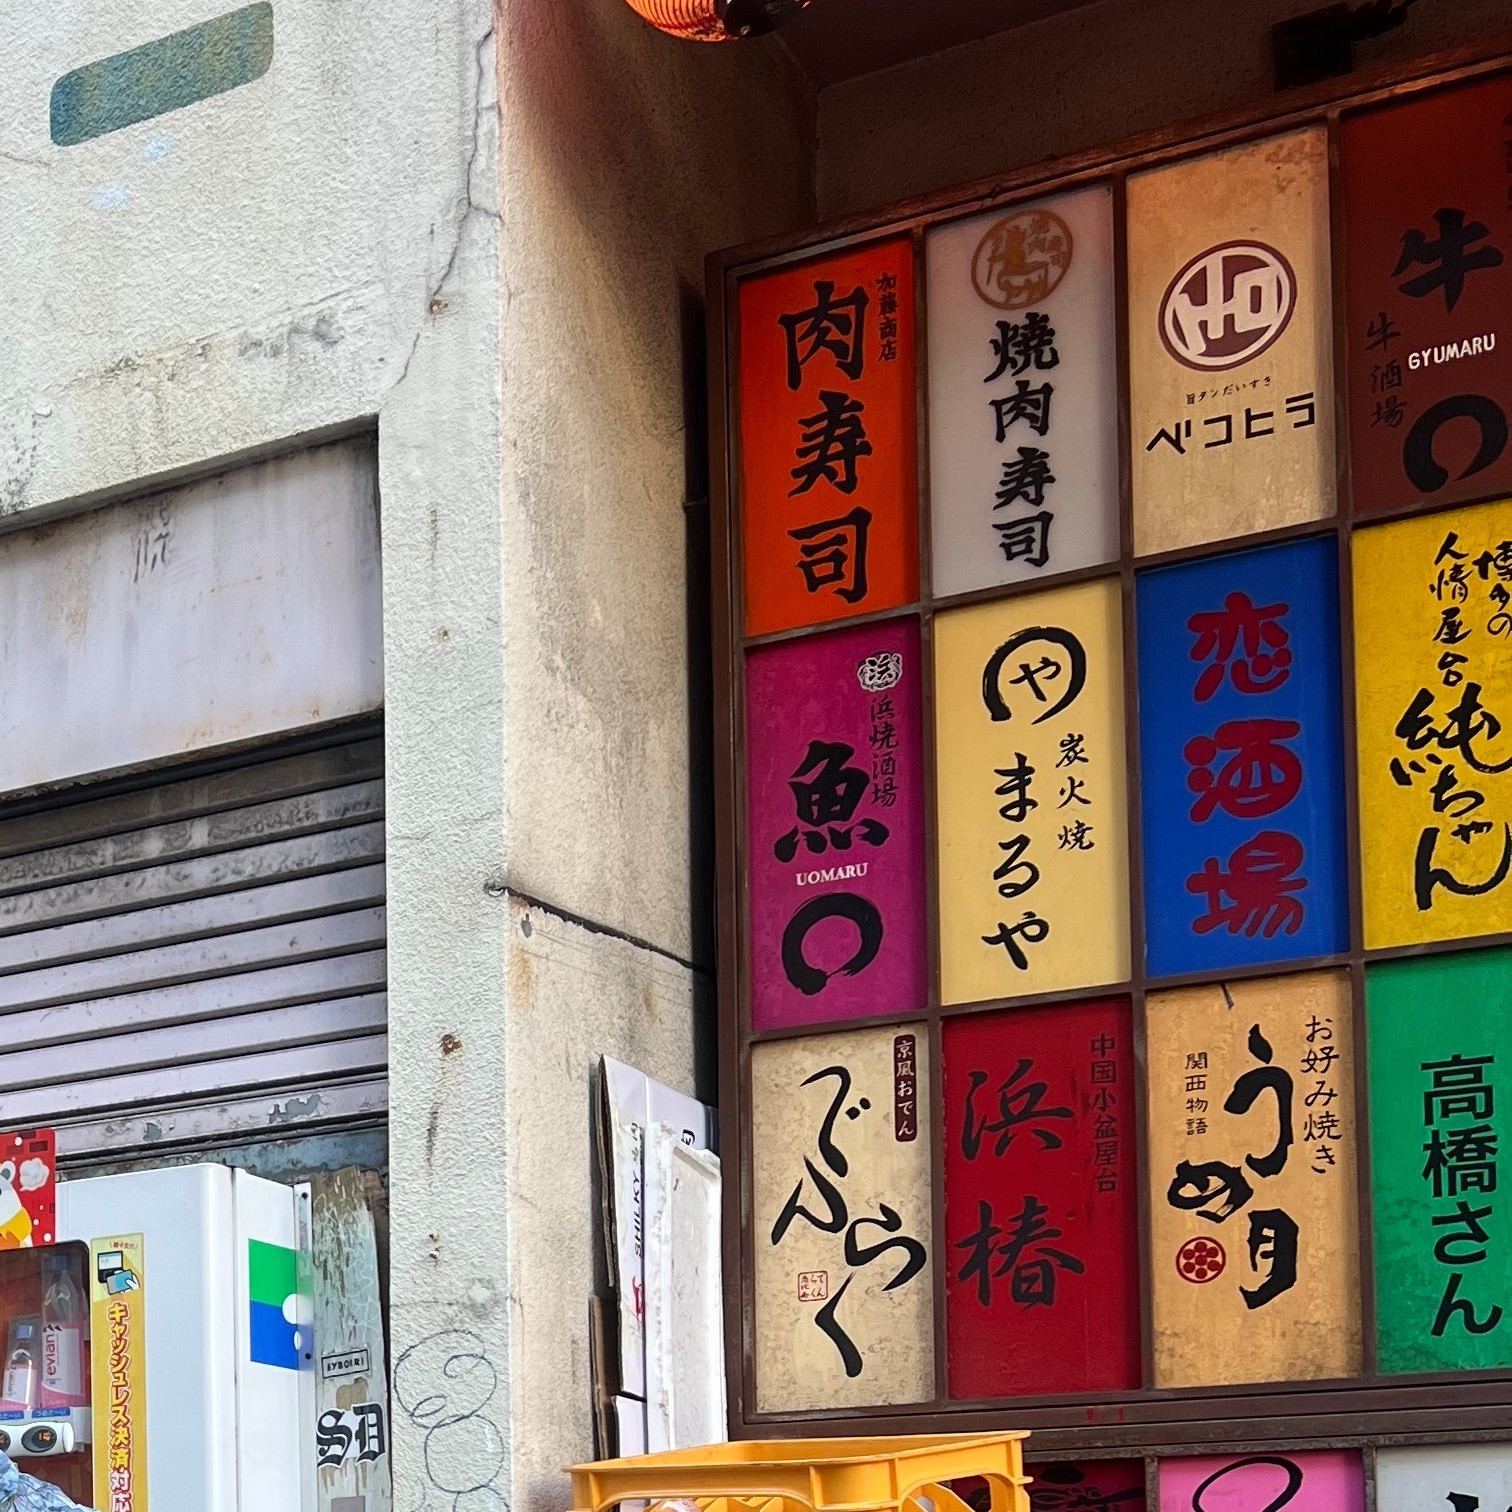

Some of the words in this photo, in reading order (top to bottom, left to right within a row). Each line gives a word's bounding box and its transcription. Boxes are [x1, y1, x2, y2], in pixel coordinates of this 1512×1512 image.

[1391, 207, 1503, 313] 牛
[1365, 312, 1405, 429] 牛酒場
[1408, 333, 1496, 370] GYUMARU
[777, 280, 873, 604] 肉寿司
[774, 740, 890, 863] 魚
[869, 697, 900, 808] 浜焼酒場
[1055, 733, 1096, 851] 炭火焼
[1183, 592, 1309, 939] 恋酒場
[795, 862, 869, 888] UOMARU
[981, 751, 1050, 971] まるや
[895, 1039, 916, 1137] 京風おでん
[1184, 1050, 1209, 1137] 関西物語
[1299, 1015, 1343, 1175] お好み焼き
[954, 1058, 1086, 1308] 浜椿
[1420, 1053, 1503, 1338] 高橋さん
[45, 1334, 57, 1377] evian
